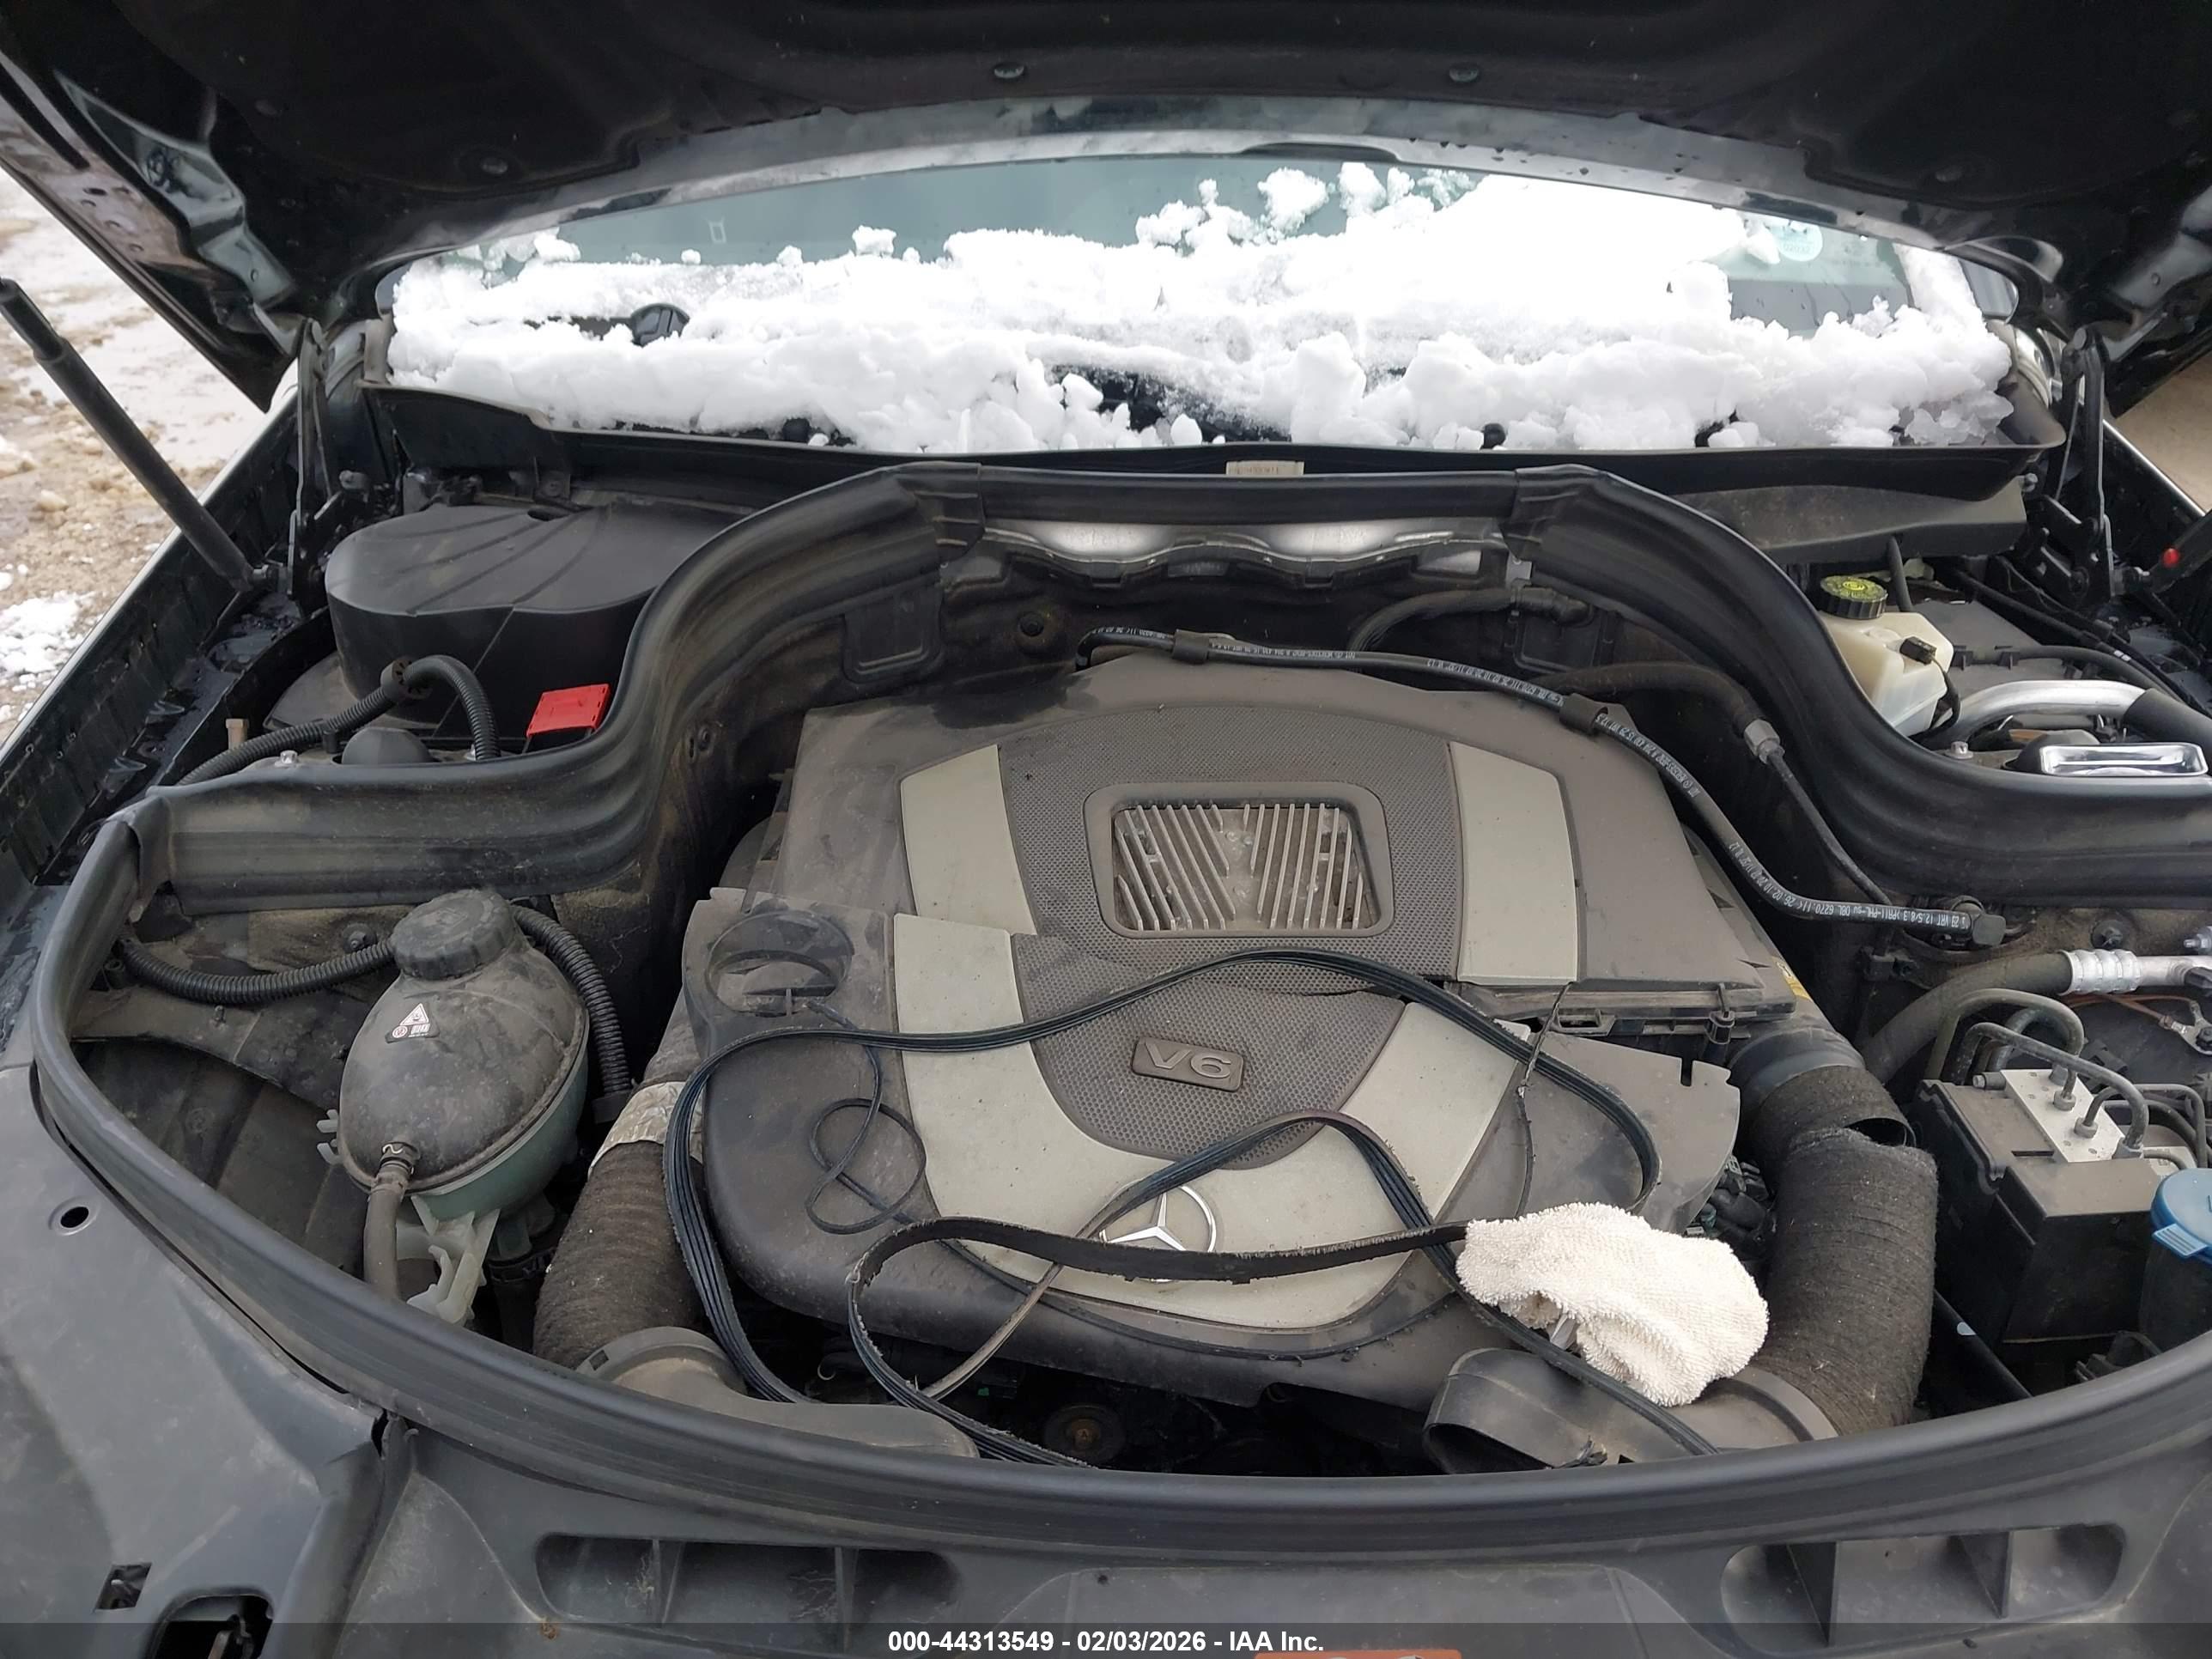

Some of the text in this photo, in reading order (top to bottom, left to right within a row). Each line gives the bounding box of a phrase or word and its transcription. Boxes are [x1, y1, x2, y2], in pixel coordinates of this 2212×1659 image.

[1901, 908, 1934, 926] 12.5/8.3
[1936, 913, 1949, 927] VRT
[1146, 1041, 1232, 1079] V6
